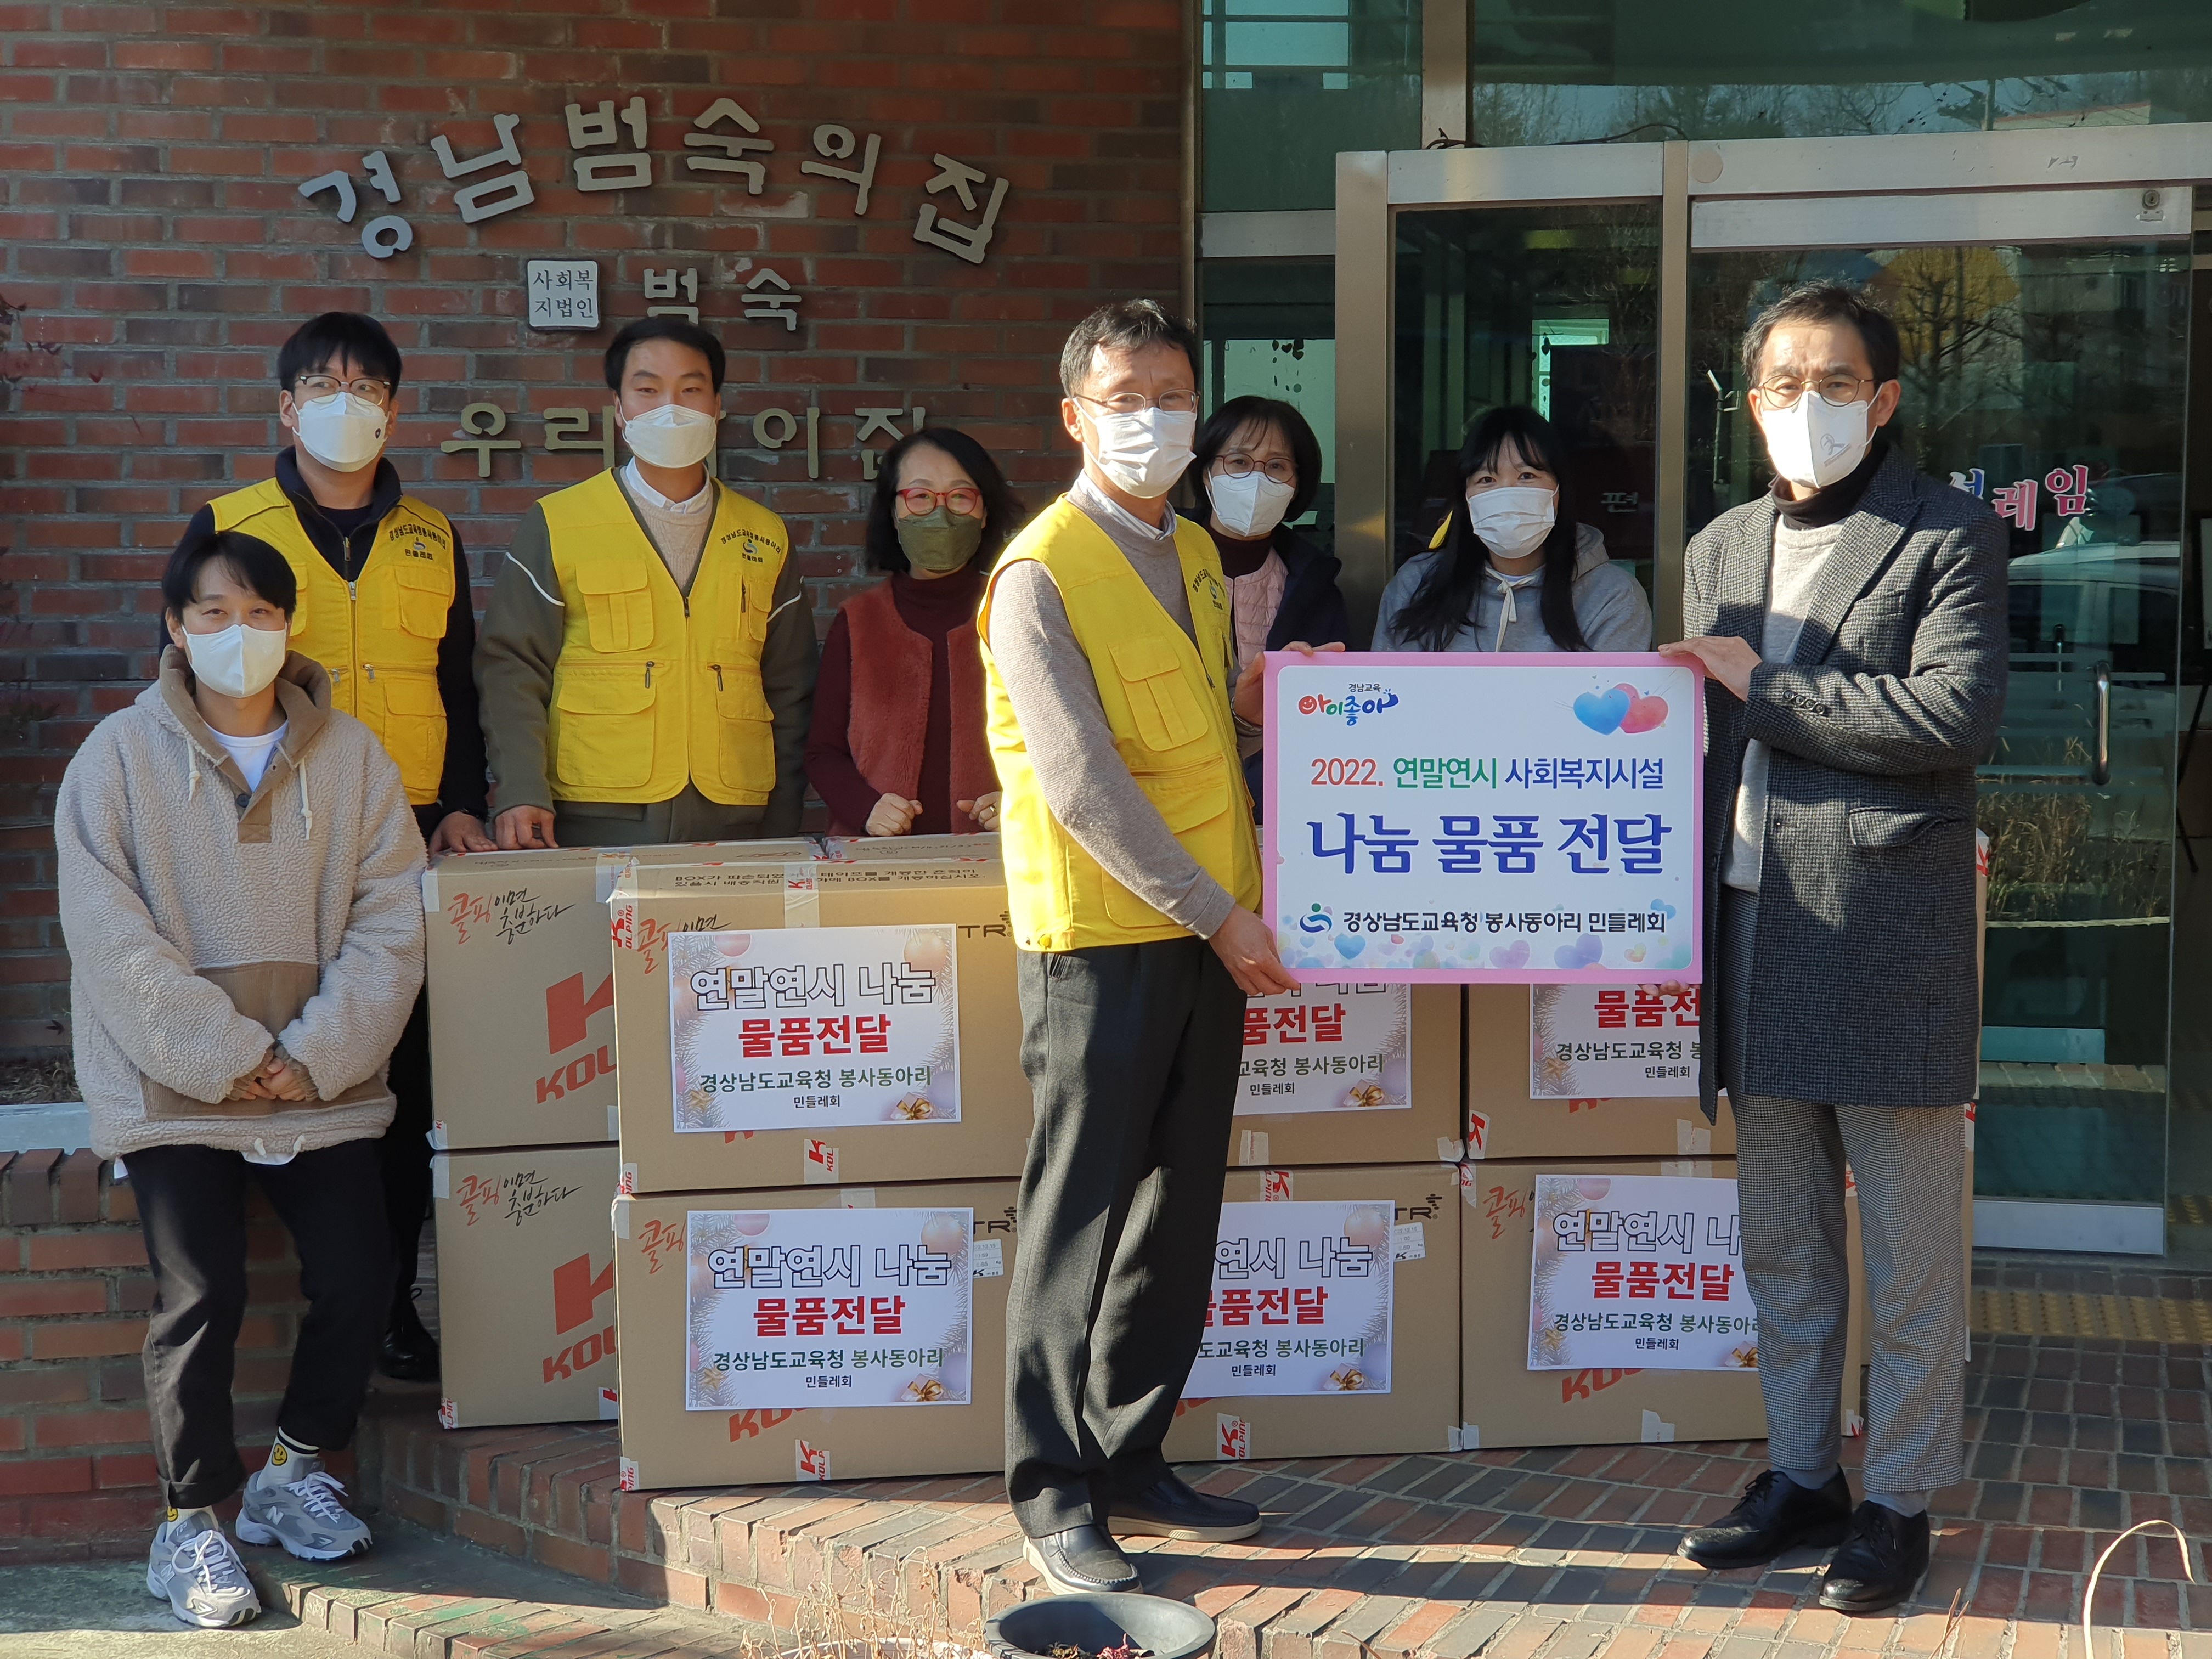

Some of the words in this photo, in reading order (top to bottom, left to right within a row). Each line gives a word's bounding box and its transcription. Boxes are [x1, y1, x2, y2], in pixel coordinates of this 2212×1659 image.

[533, 269, 594, 291] 사회복
[534, 297, 594, 319] 지법인
[1348, 683, 1381, 692] 경남교육
[1298, 693, 1399, 726] 아이좋아
[1311, 757, 1384, 787] 2022.
[1393, 757, 1498, 789] 연말연시
[1504, 757, 1664, 790] 사회복지시설
[1306, 812, 1419, 875] 나눔
[1432, 813, 1544, 875] 물품
[1557, 812, 1673, 876] 전달
[1343, 911, 1479, 934] 경상남도교육청
[1485, 911, 1581, 934] 봉사동아리
[1588, 911, 1666, 934] 민들레회
[690, 963, 845, 1011] 연말연시
[857, 962, 936, 1005] 나눔
[738, 1014, 891, 1058] 물품전달
[1556, 1041, 1682, 1062] 경상남도교육청
[1294, 1053, 1384, 1076] 봉사동아리
[1645, 1065, 1690, 1079] 민들레회
[700, 1069, 831, 1093] 경상남도교육청
[838, 1065, 932, 1088] 봉사동아리
[1250, 1082, 1295, 1096] 민들레회
[793, 1094, 840, 1109] 민들레회
[1553, 1210, 1695, 1255] 연말연시
[708, 1244, 861, 1289] 연말연시
[874, 1244, 952, 1286] 나눔
[1299, 1237, 1373, 1278] 나눔
[1591, 1261, 1735, 1302] 물품전달
[753, 1295, 906, 1338] 물품전달
[1554, 1312, 1673, 1333] 경상남도교육청
[1276, 1338, 1365, 1358] 봉사동아리
[1635, 1336, 1679, 1351] 민들레회
[713, 1350, 844, 1372] 경상남도교육청
[851, 1348, 944, 1369] 봉사동아리
[1231, 1364, 1276, 1377] 민들레회
[805, 1375, 853, 1389] 민들레회
